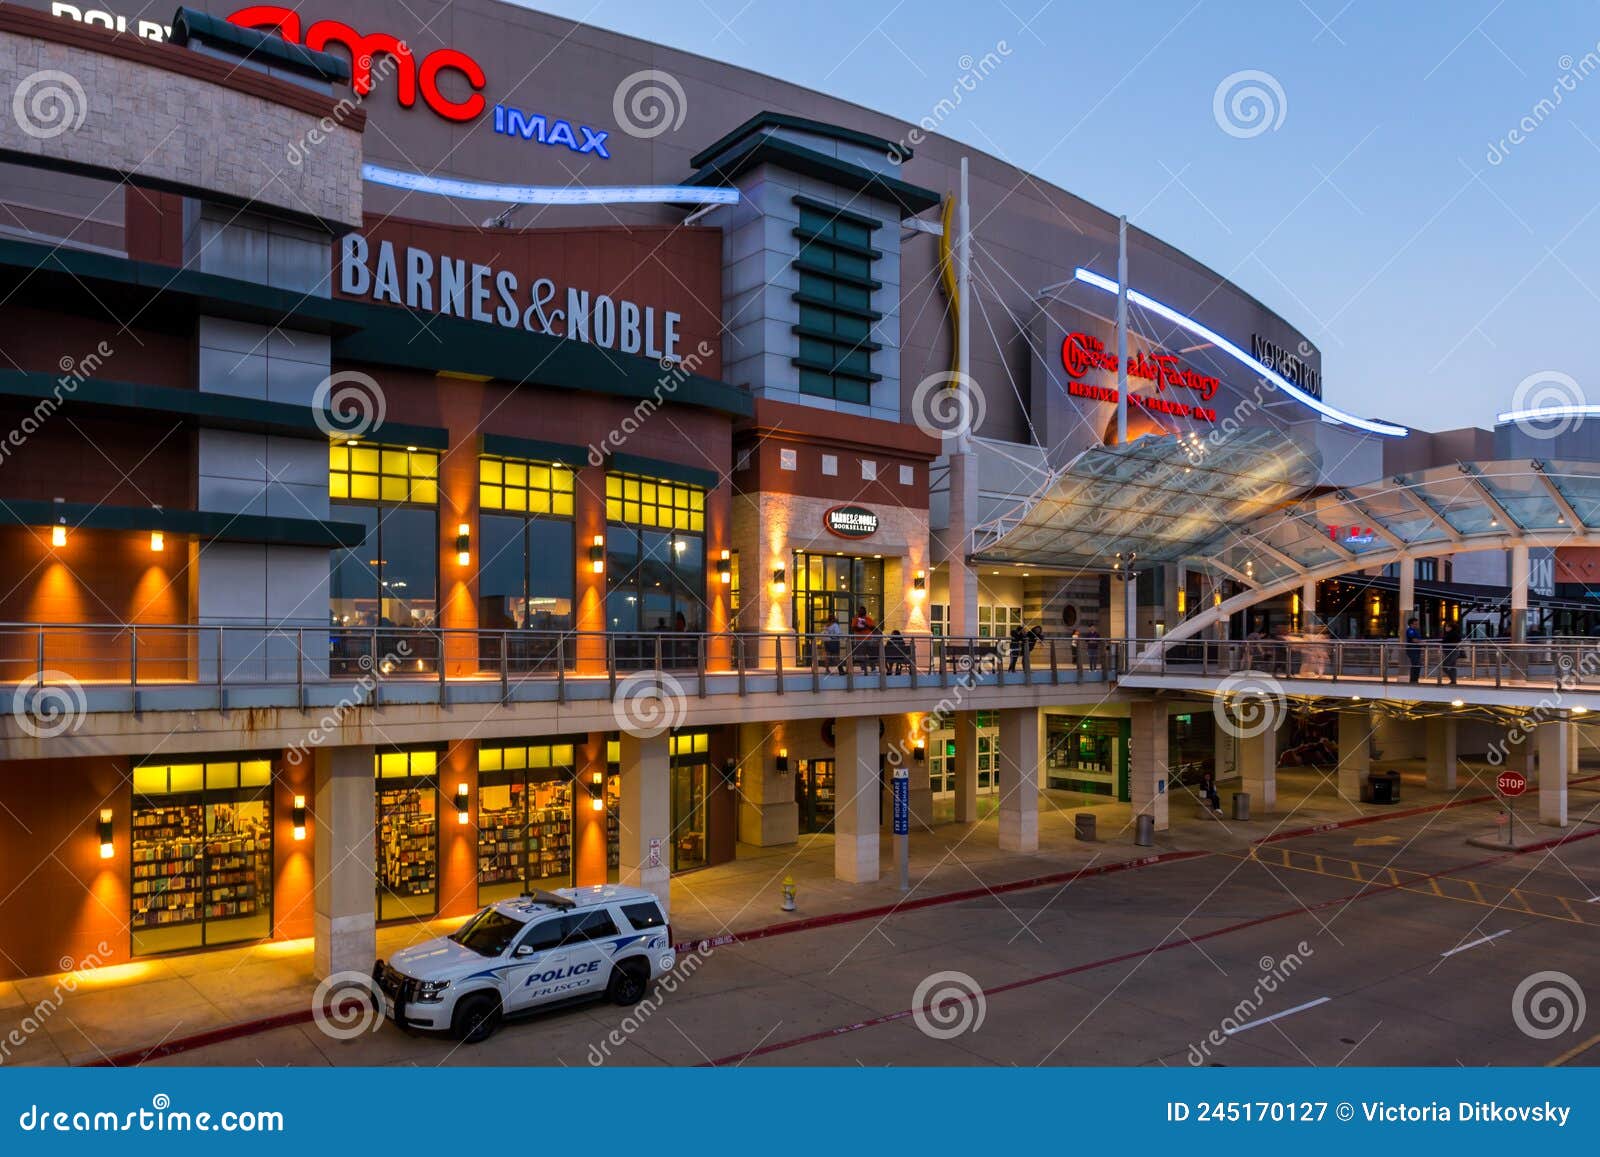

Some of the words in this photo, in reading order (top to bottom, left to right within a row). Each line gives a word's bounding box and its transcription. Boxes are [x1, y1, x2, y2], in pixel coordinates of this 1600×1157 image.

[494, 103, 611, 160] IMAX
[1062, 333, 1158, 381] Cheeseake
[1150, 352, 1220, 401] Factory
[834, 523, 875, 532] BOOKSELLERS
[1499, 778, 1524, 789] STOP
[525, 960, 601, 987] POLICE
[532, 979, 591, 998] FRISCO
